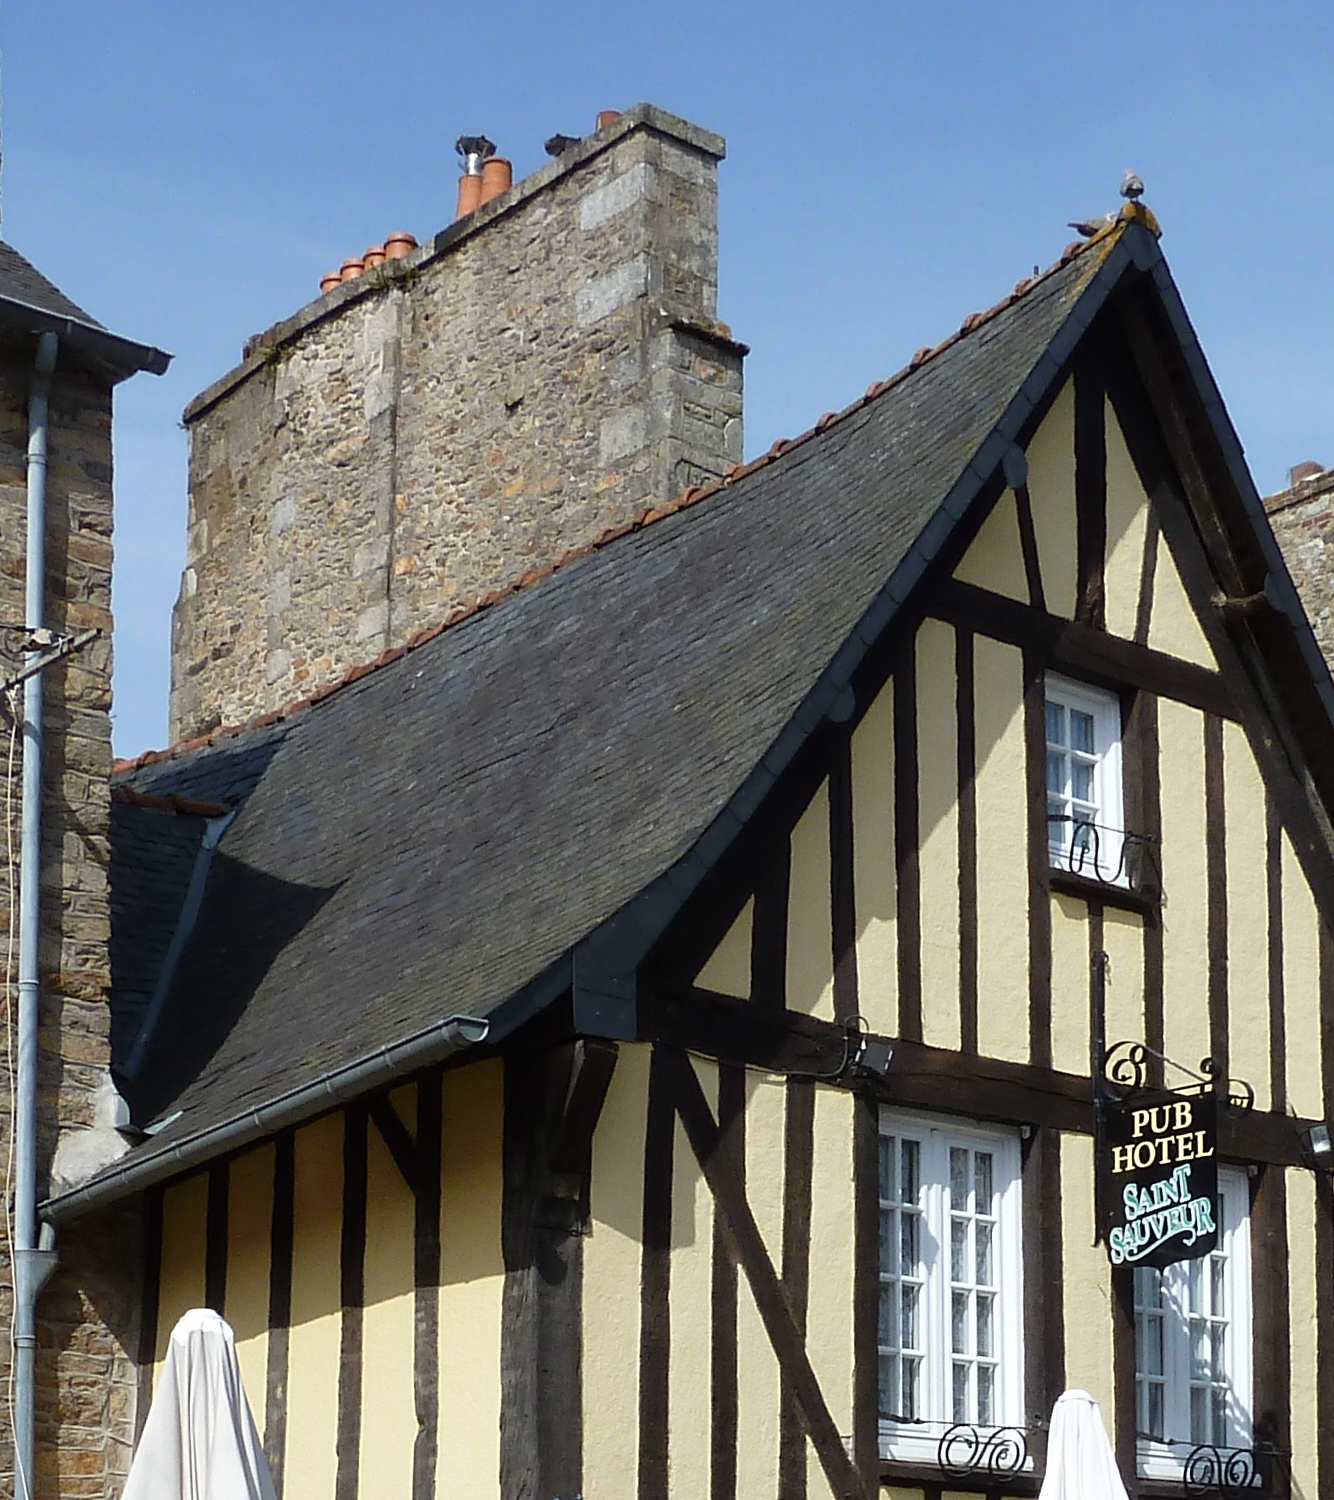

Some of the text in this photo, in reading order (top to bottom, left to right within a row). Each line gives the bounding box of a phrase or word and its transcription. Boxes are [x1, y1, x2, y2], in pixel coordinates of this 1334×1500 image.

[1131, 1101, 1192, 1138] PUB
[1111, 1130, 1214, 1173] HOTEL
[1109, 1197, 1217, 1264] SAUVEUR
